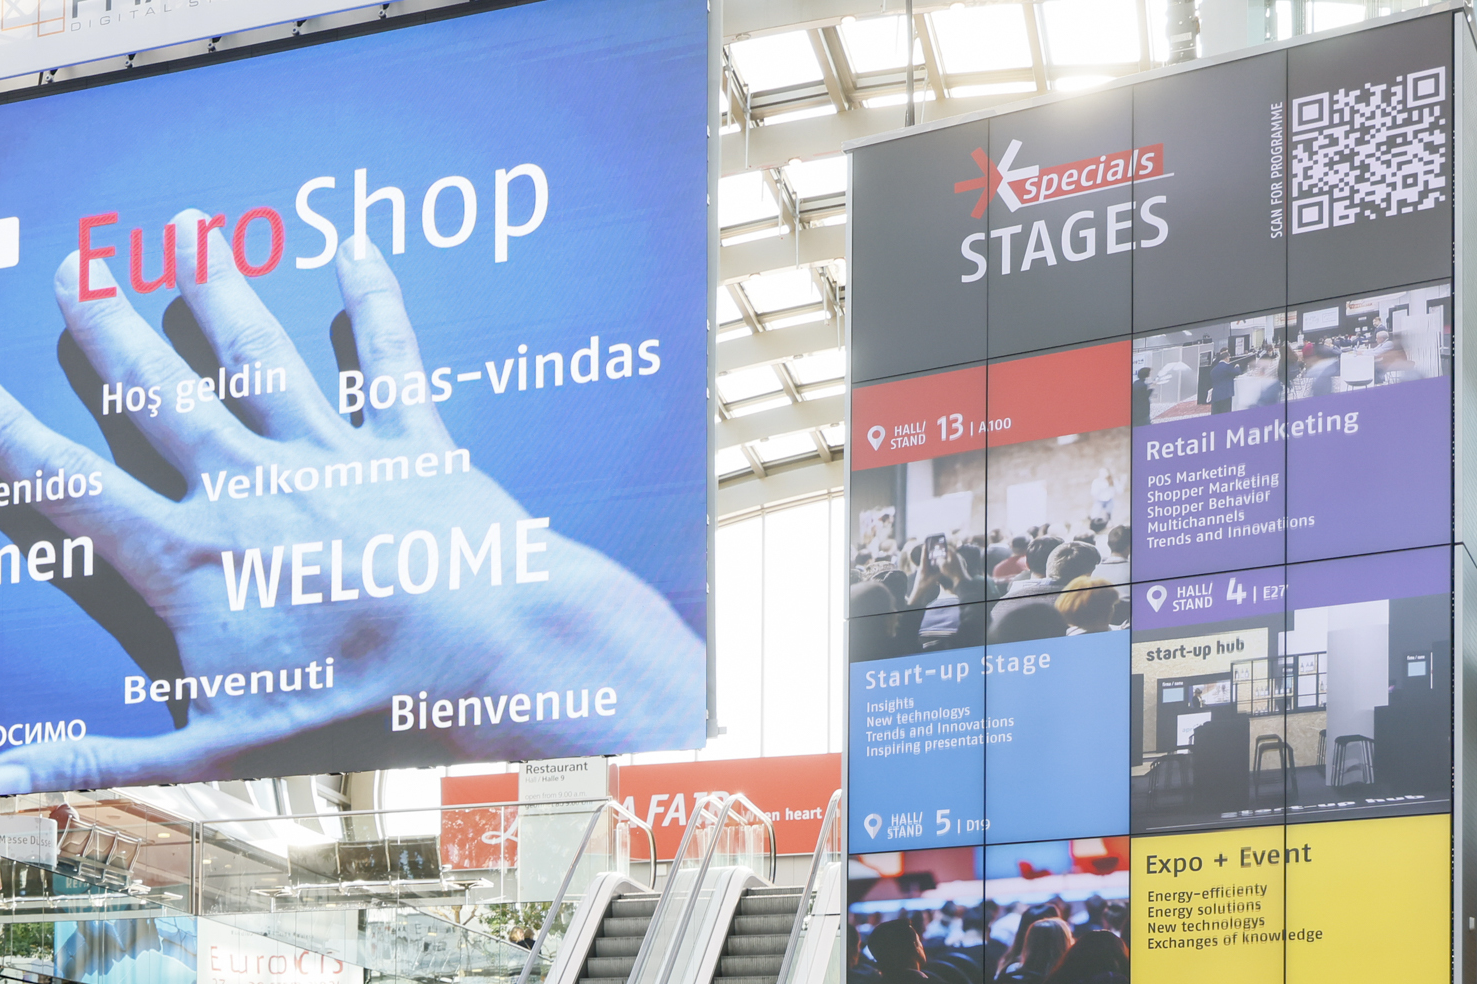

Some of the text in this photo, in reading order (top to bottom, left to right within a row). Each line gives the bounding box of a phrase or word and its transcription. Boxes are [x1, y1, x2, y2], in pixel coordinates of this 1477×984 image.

[1022, 149, 1155, 201] specials
[1270, 101, 1283, 239] SCAN FOR PROGRAMME
[78, 163, 549, 302] EuroShop
[961, 195, 1169, 283] STAGES
[338, 335, 661, 415] Boas-vindas
[102, 360, 287, 417] Hoş geldin
[894, 421, 926, 437] HALL/
[936, 413, 964, 442] 13
[1146, 411, 1359, 461] Retail Marketing
[890, 434, 926, 450] STAND
[201, 448, 471, 502] Velkommen
[1148, 463, 1246, 488] POS Marketing
[1147, 473, 1280, 505] Shopper Marketing
[1147, 490, 1271, 521] Shopper Behavior
[1147, 515, 1316, 549] Trends and Innovations
[1148, 508, 1245, 533] Multichannels
[222, 517, 550, 612] WELCOME
[1177, 583, 1213, 598] HALL/
[1227, 577, 1247, 605] 4
[1173, 596, 1213, 612] STAND
[1146, 636, 1245, 662] start-up hub
[124, 656, 335, 705] Benvenuti
[865, 653, 1051, 690] Start-up Stage
[391, 686, 618, 732] Bienvenue
[866, 696, 915, 713] Insights
[866, 706, 971, 728] New technologys
[866, 717, 1015, 743] Trends and Innovations
[866, 732, 1013, 757] Inspiring presentations
[526, 762, 588, 774] Restaurant
[785, 806, 823, 821] heart
[891, 811, 923, 826] HALL/
[936, 809, 991, 835] 5 D19
[887, 823, 923, 839] STAND
[1146, 854, 1203, 878] Expo
[1240, 844, 1312, 869] Event
[1147, 901, 1262, 919] Energy solutions
[1147, 916, 1265, 934] New technologys
[1147, 928, 1323, 950] Exchanges of knowledge
